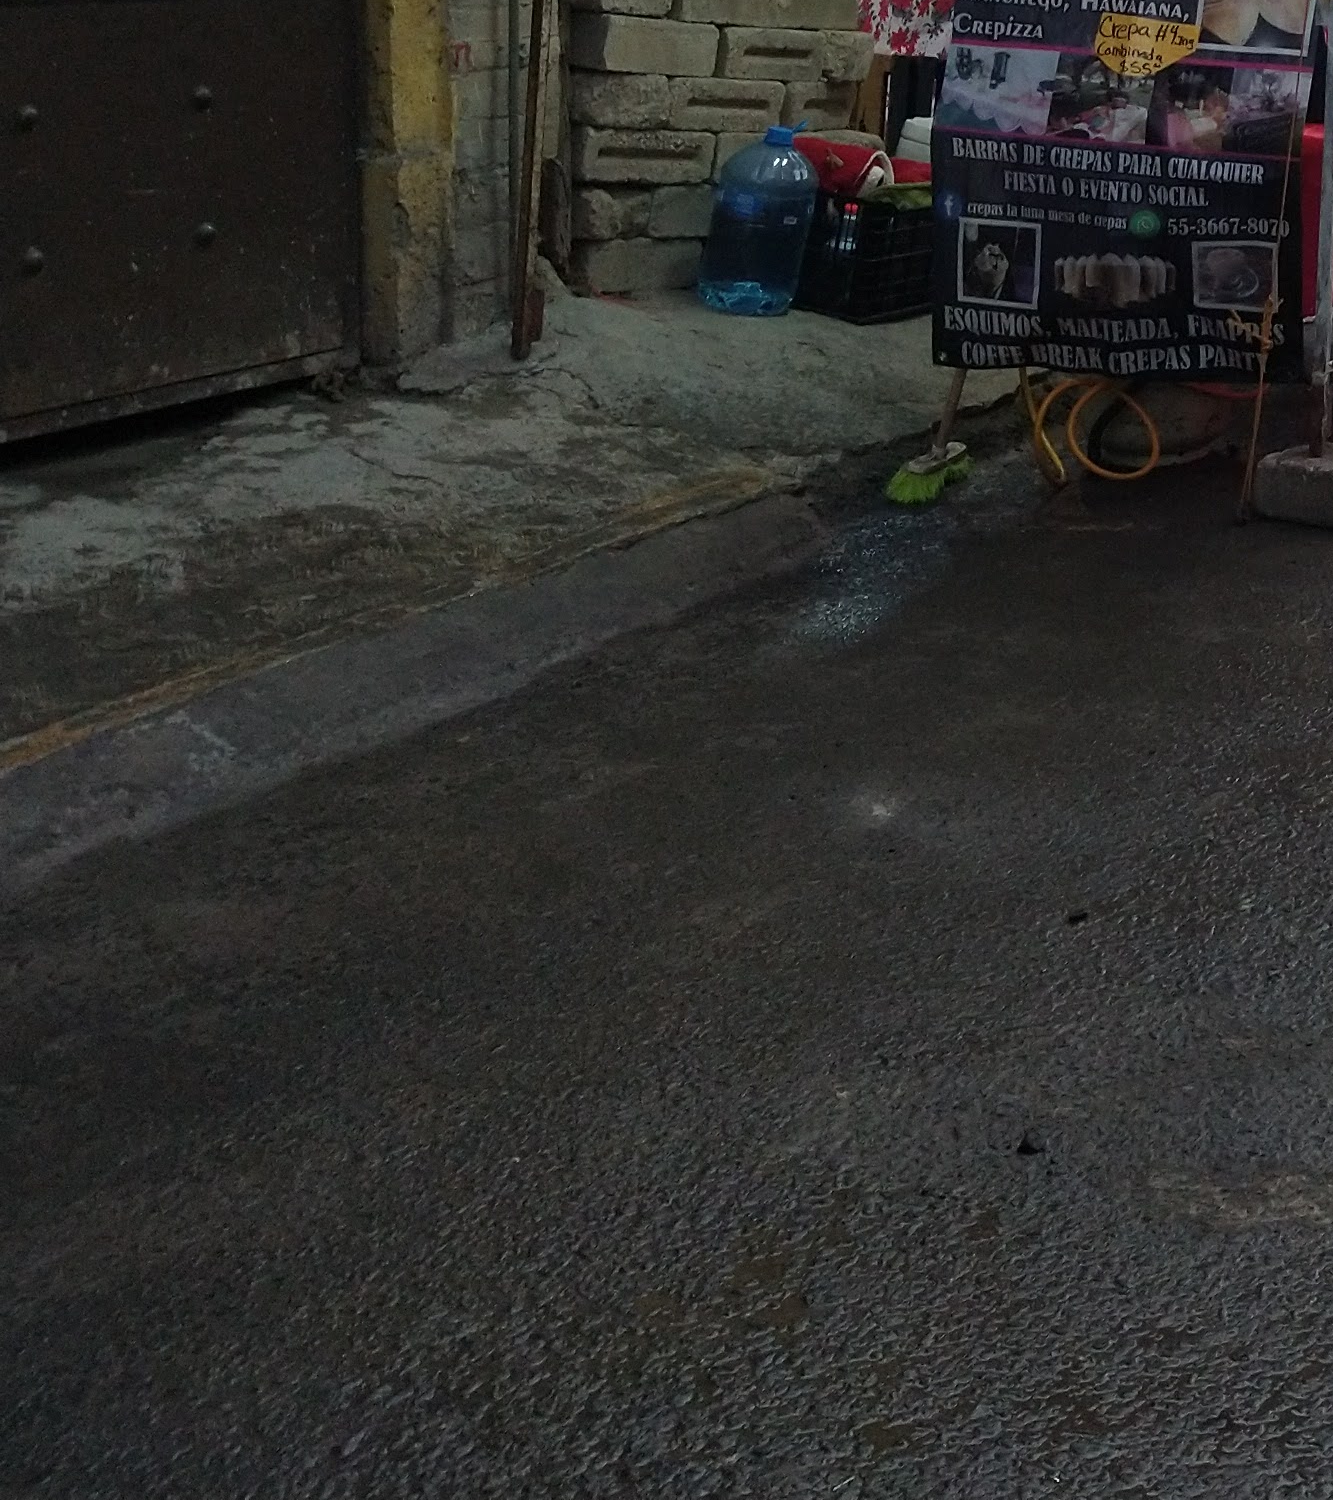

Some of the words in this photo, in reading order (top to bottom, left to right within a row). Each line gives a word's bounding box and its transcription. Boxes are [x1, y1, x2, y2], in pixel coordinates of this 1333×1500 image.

[953, 12, 1043, 40] Crepizza
[1100, 16, 1150, 40] Crepa
[952, 137, 1018, 162] BARRAS
[1022, 144, 1046, 166] DE
[1050, 147, 1112, 172] CREPAS
[1118, 152, 1162, 178] PARA
[1167, 158, 1265, 186] CUALQUIER
[1004, 170, 1057, 195] FIESTA
[1079, 178, 1143, 203] EVENTO
[1148, 184, 1209, 207] SOCIAL
[967, 203, 1003, 218] crepas
[1078, 211, 1092, 225] de
[1094, 214, 1127, 231] crepas
[961, 340, 1025, 367] COFFE
[1030, 343, 1102, 370] BREAK
[1108, 345, 1191, 375] CREPAS
